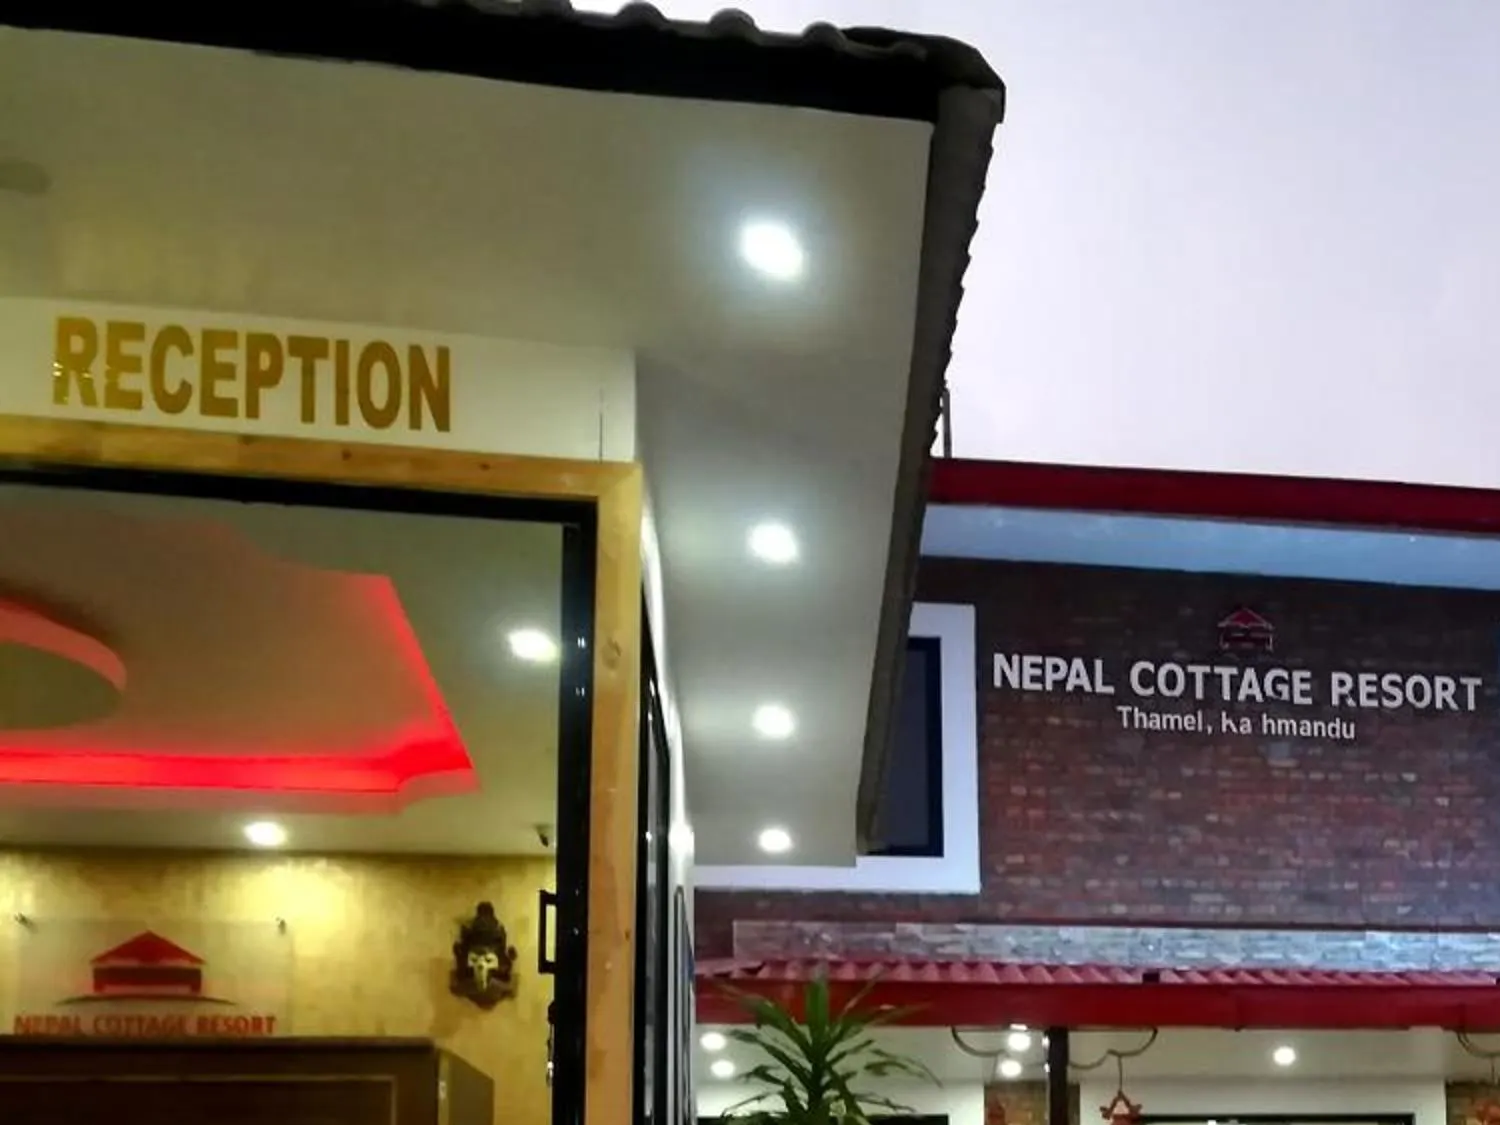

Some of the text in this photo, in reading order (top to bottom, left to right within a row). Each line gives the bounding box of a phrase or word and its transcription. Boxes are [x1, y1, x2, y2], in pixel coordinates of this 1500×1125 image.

[52, 316, 453, 433] RECEPTION
[992, 653, 1483, 712] NEPAL COTTAGE RESORT
[1116, 705, 1214, 735] Thamel,
[14, 1014, 277, 1036] NEPAL COTTAGE RESORT
